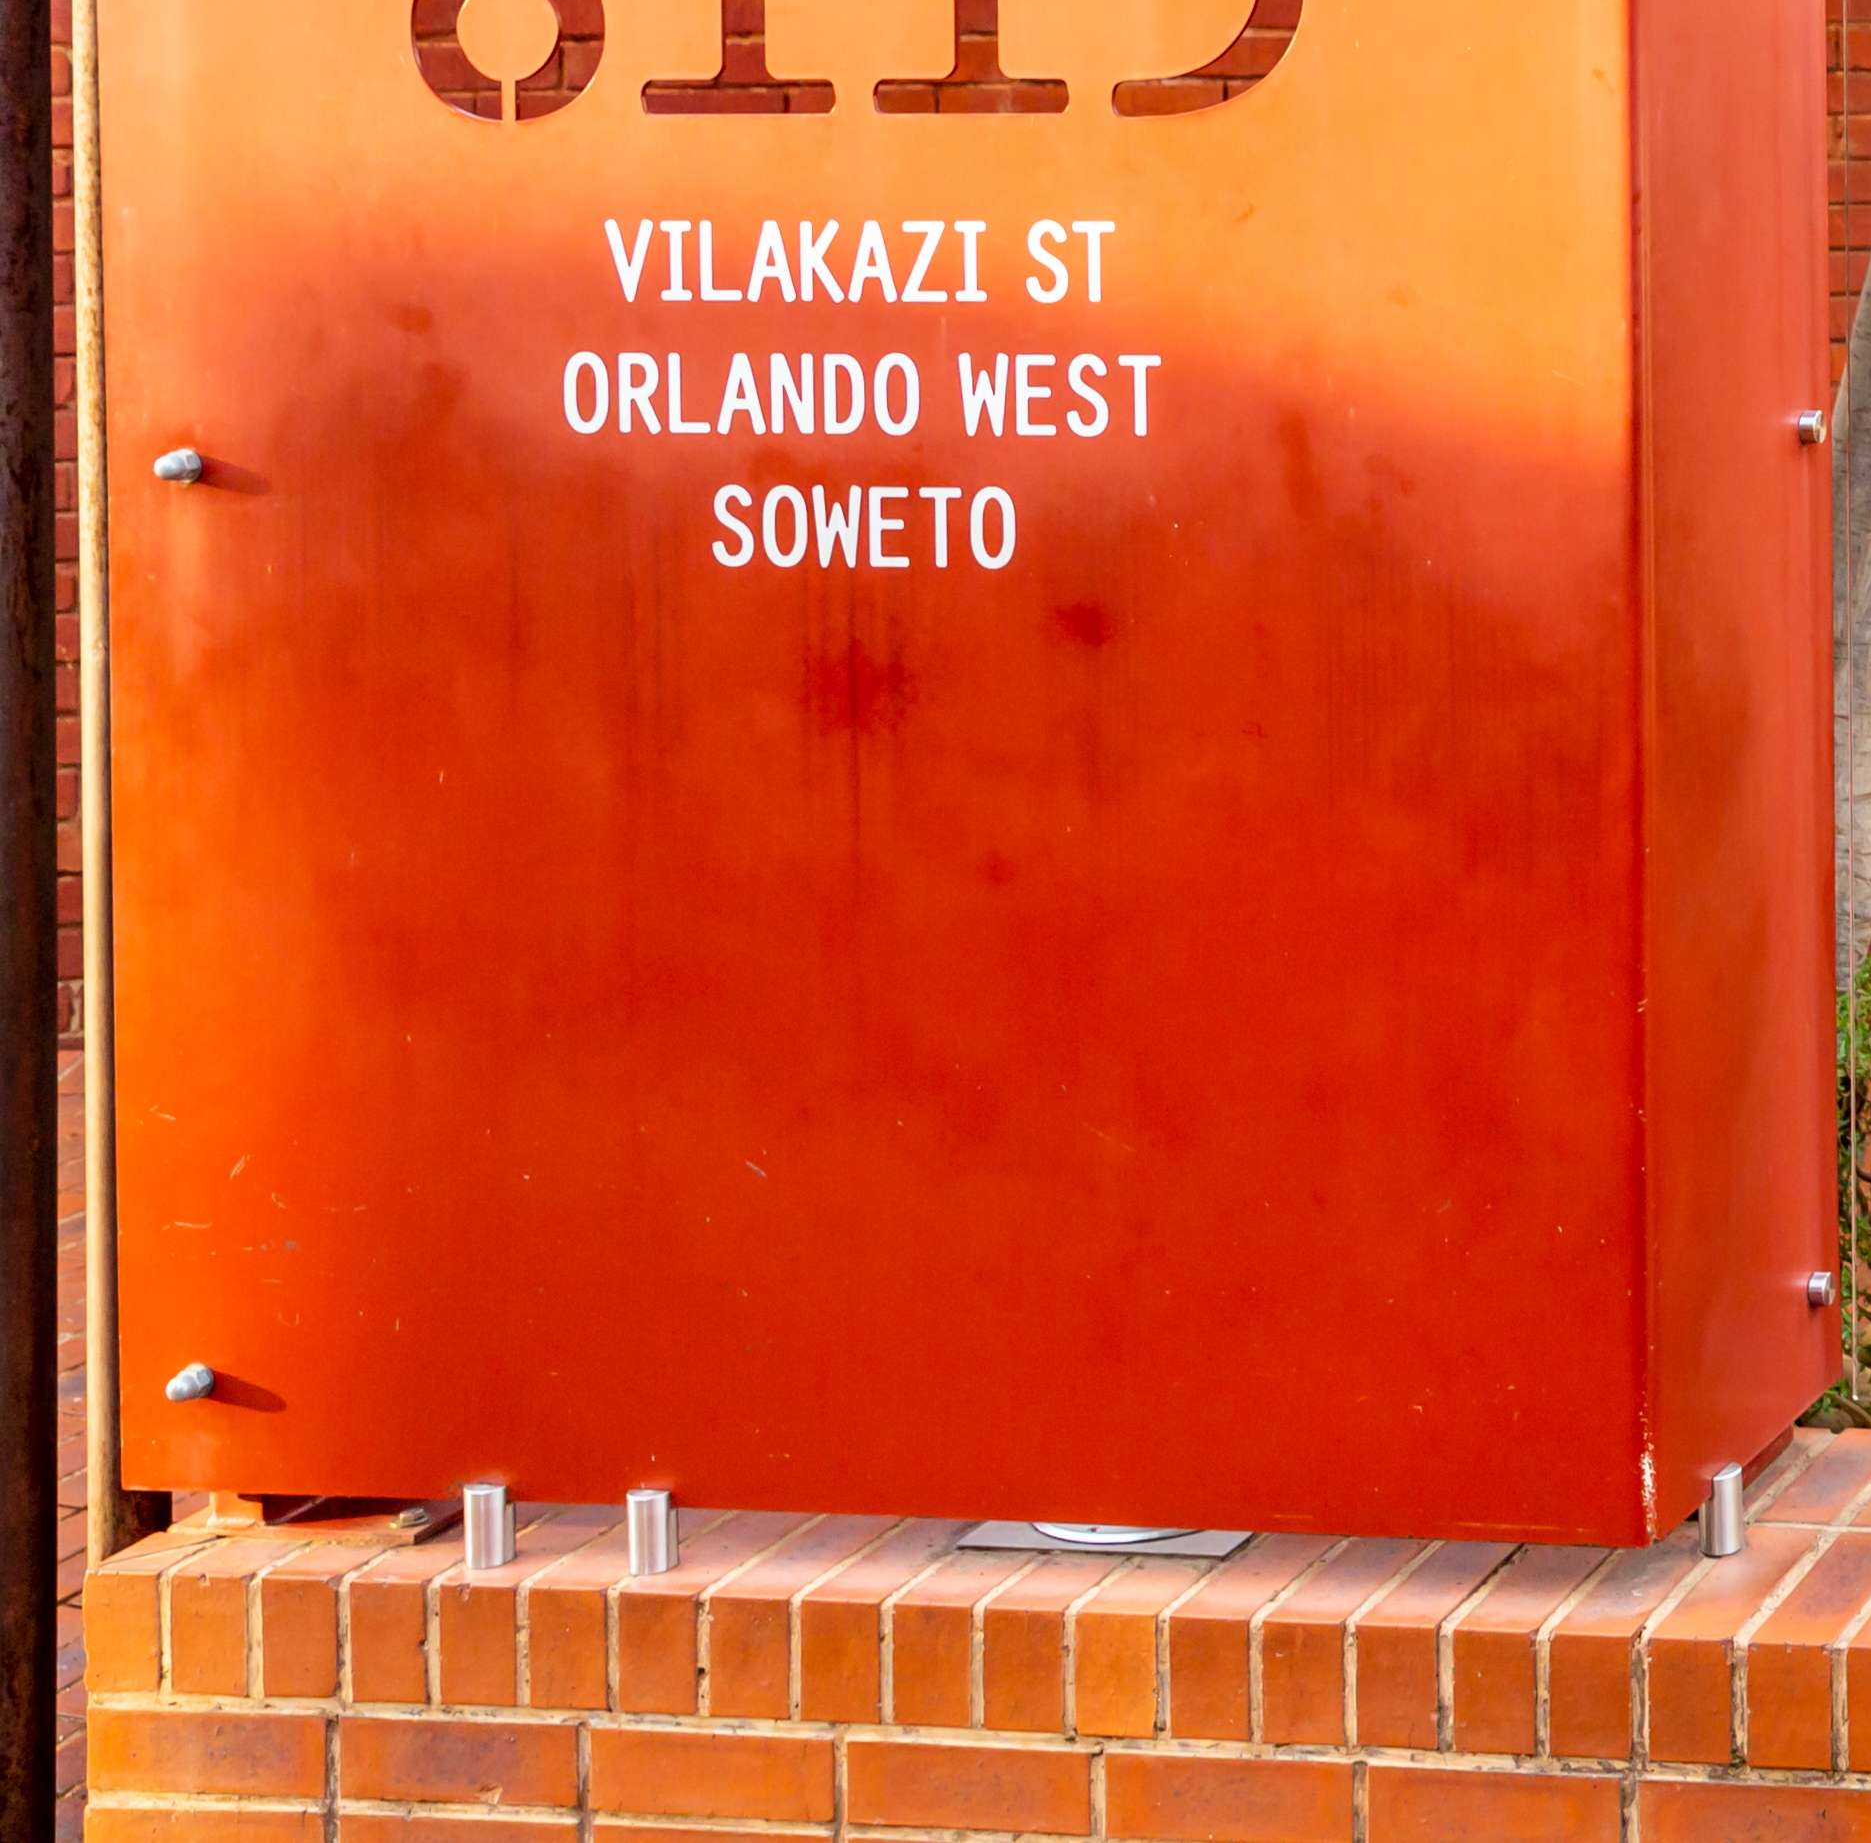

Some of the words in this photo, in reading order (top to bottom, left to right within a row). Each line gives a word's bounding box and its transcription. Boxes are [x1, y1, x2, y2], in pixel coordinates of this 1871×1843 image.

[604, 219, 988, 304] VILAKAZI
[1025, 219, 1117, 304] ST
[562, 352, 921, 437] ORLANDO
[959, 353, 1163, 437] WEST
[711, 485, 1018, 569] SOWETO
